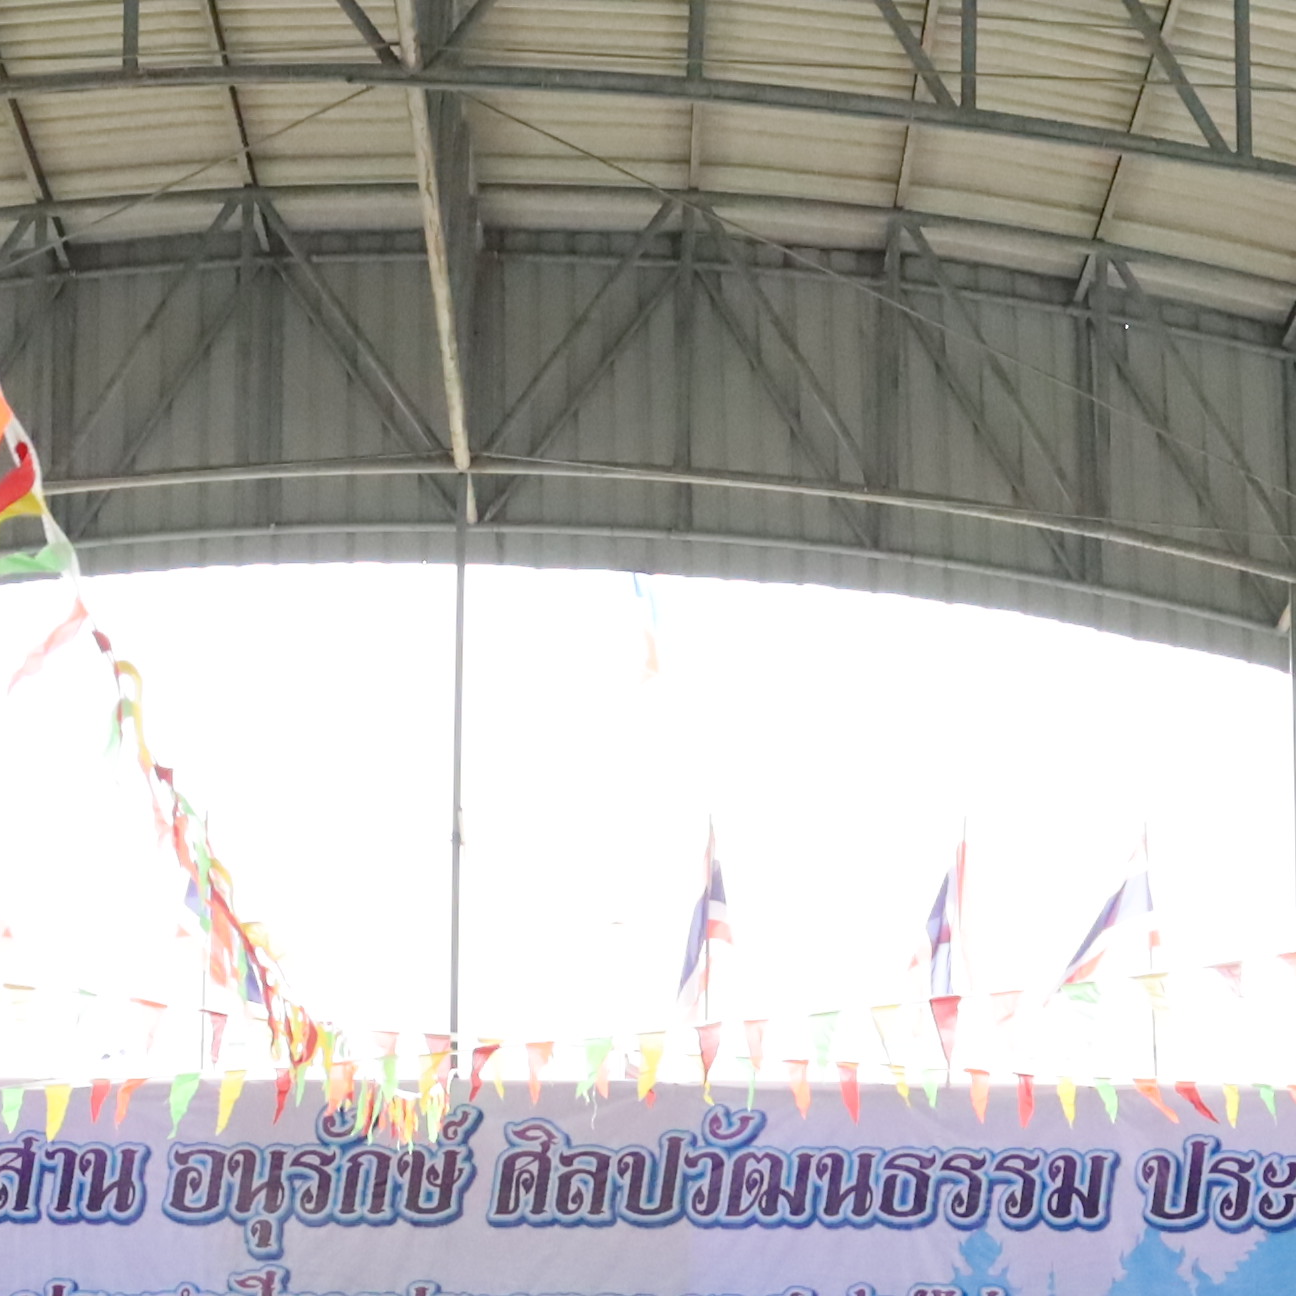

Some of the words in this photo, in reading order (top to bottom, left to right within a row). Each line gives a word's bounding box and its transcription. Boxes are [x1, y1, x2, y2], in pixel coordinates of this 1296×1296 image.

[172, 1106, 471, 1248] อนุรักษ์
[494, 1114, 1115, 1219] ศิลปวัฒนธรรม
